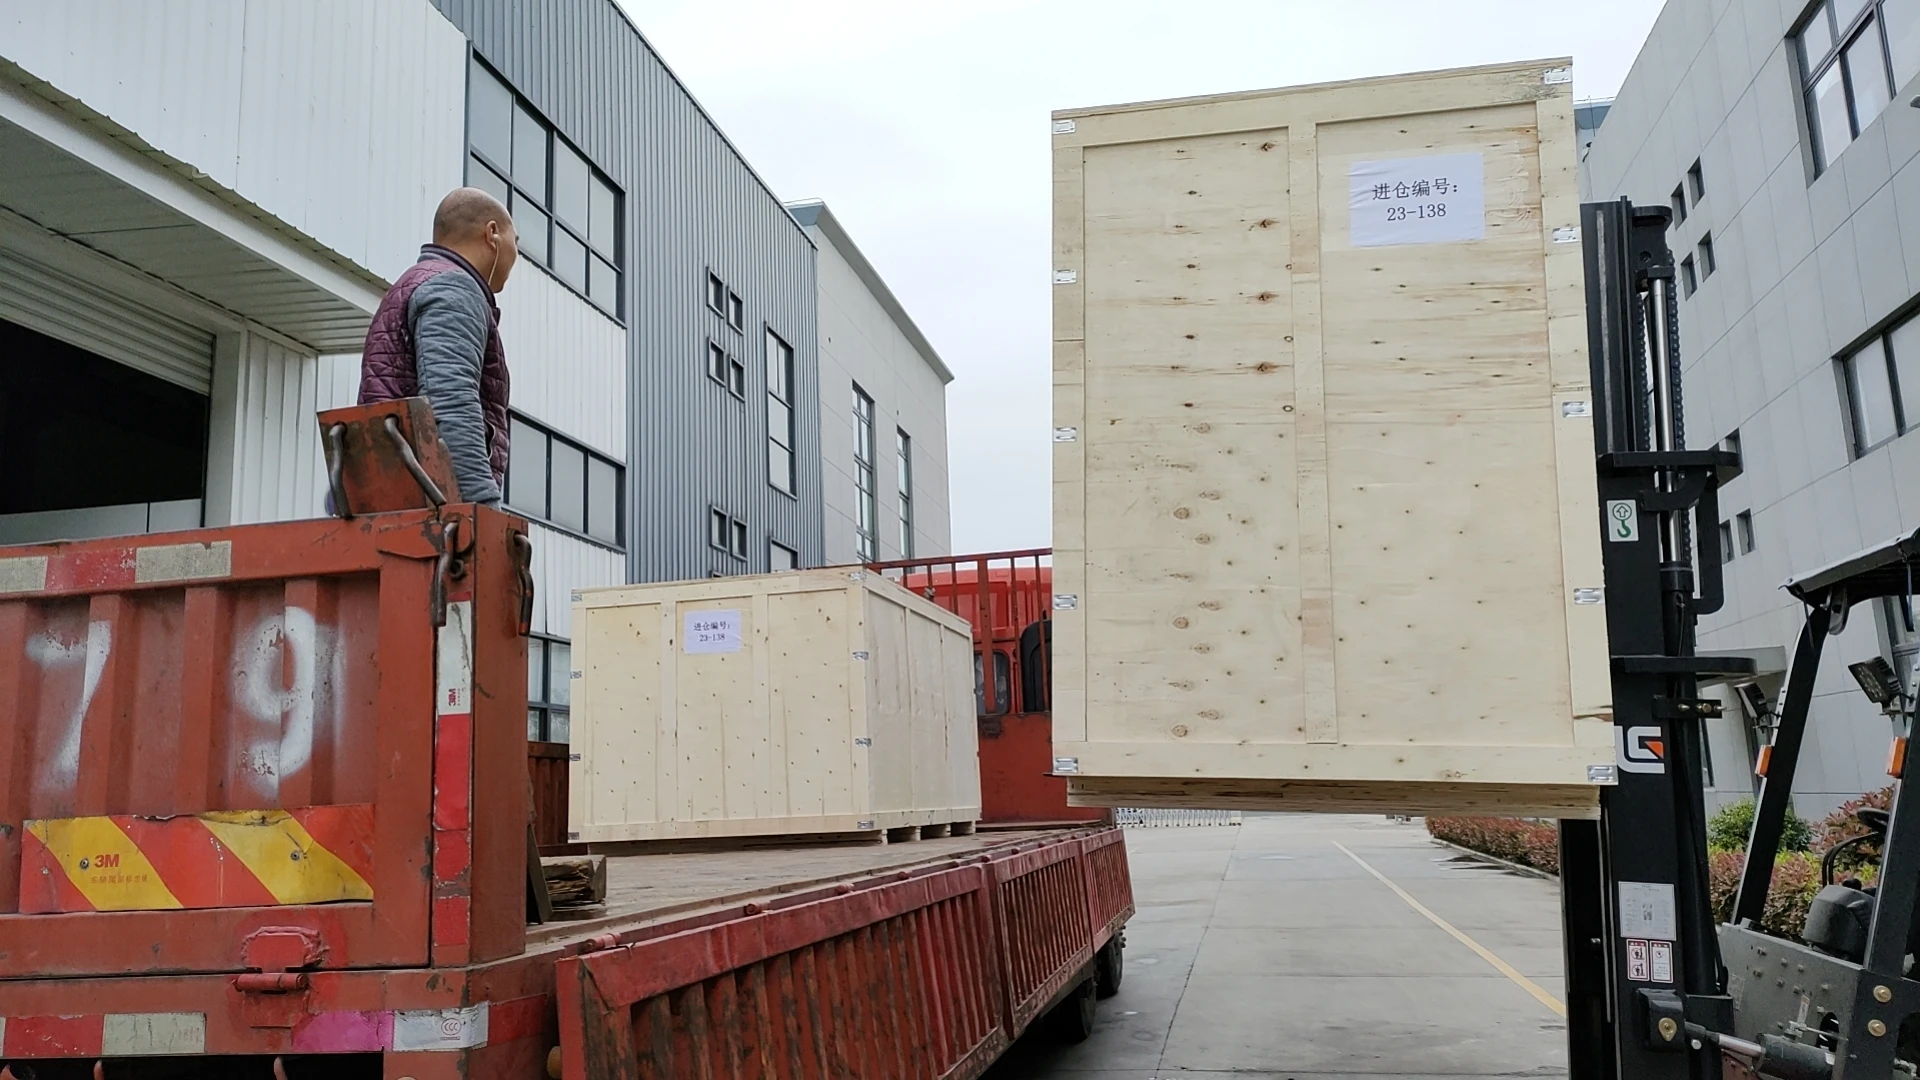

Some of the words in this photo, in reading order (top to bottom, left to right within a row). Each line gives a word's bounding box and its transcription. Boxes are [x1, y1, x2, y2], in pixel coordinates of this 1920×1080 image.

[1387, 203, 1446, 221] 23-138
[699, 633, 725, 642] 23-138
[448, 688, 456, 706] 3M
[93, 853, 120, 868] 3M
